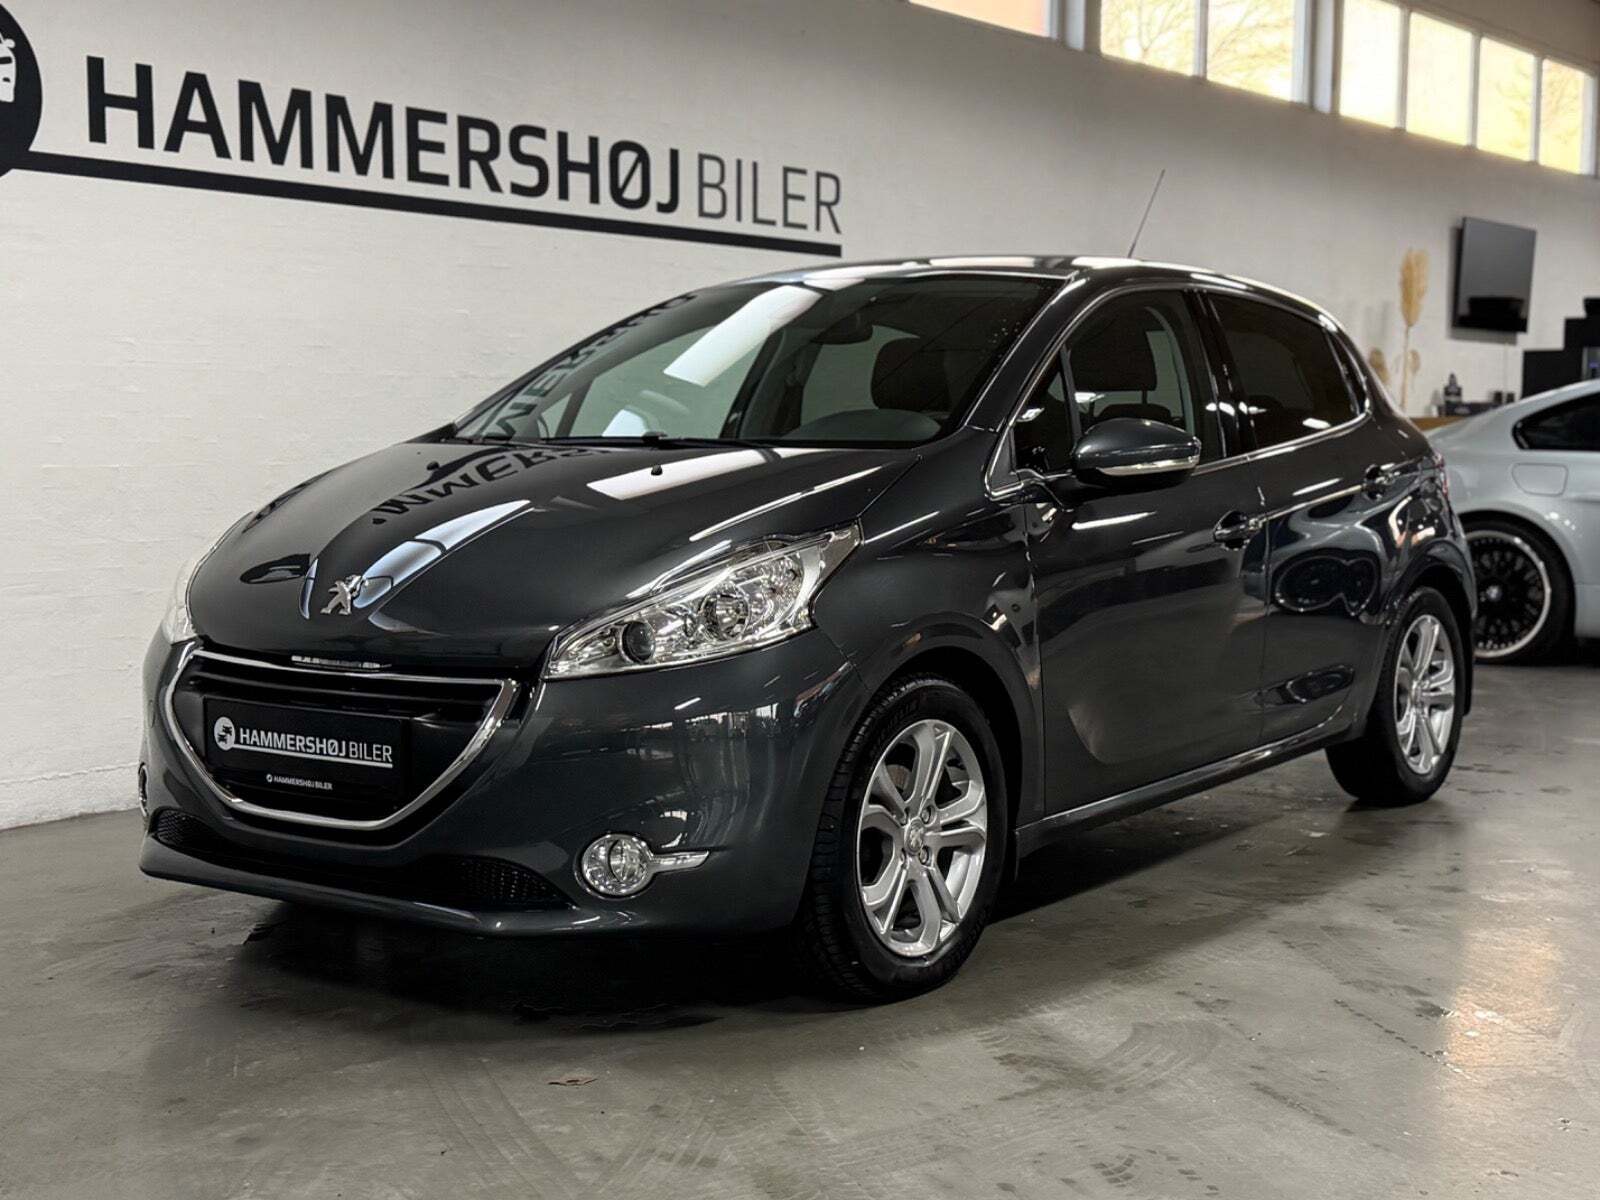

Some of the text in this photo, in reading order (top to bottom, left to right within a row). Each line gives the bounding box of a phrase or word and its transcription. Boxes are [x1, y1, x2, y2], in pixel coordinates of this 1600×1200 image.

[85, 55, 843, 235] HAMMERSHØJ BILER
[239, 727, 393, 763] HAMMERSHØJ BILER
